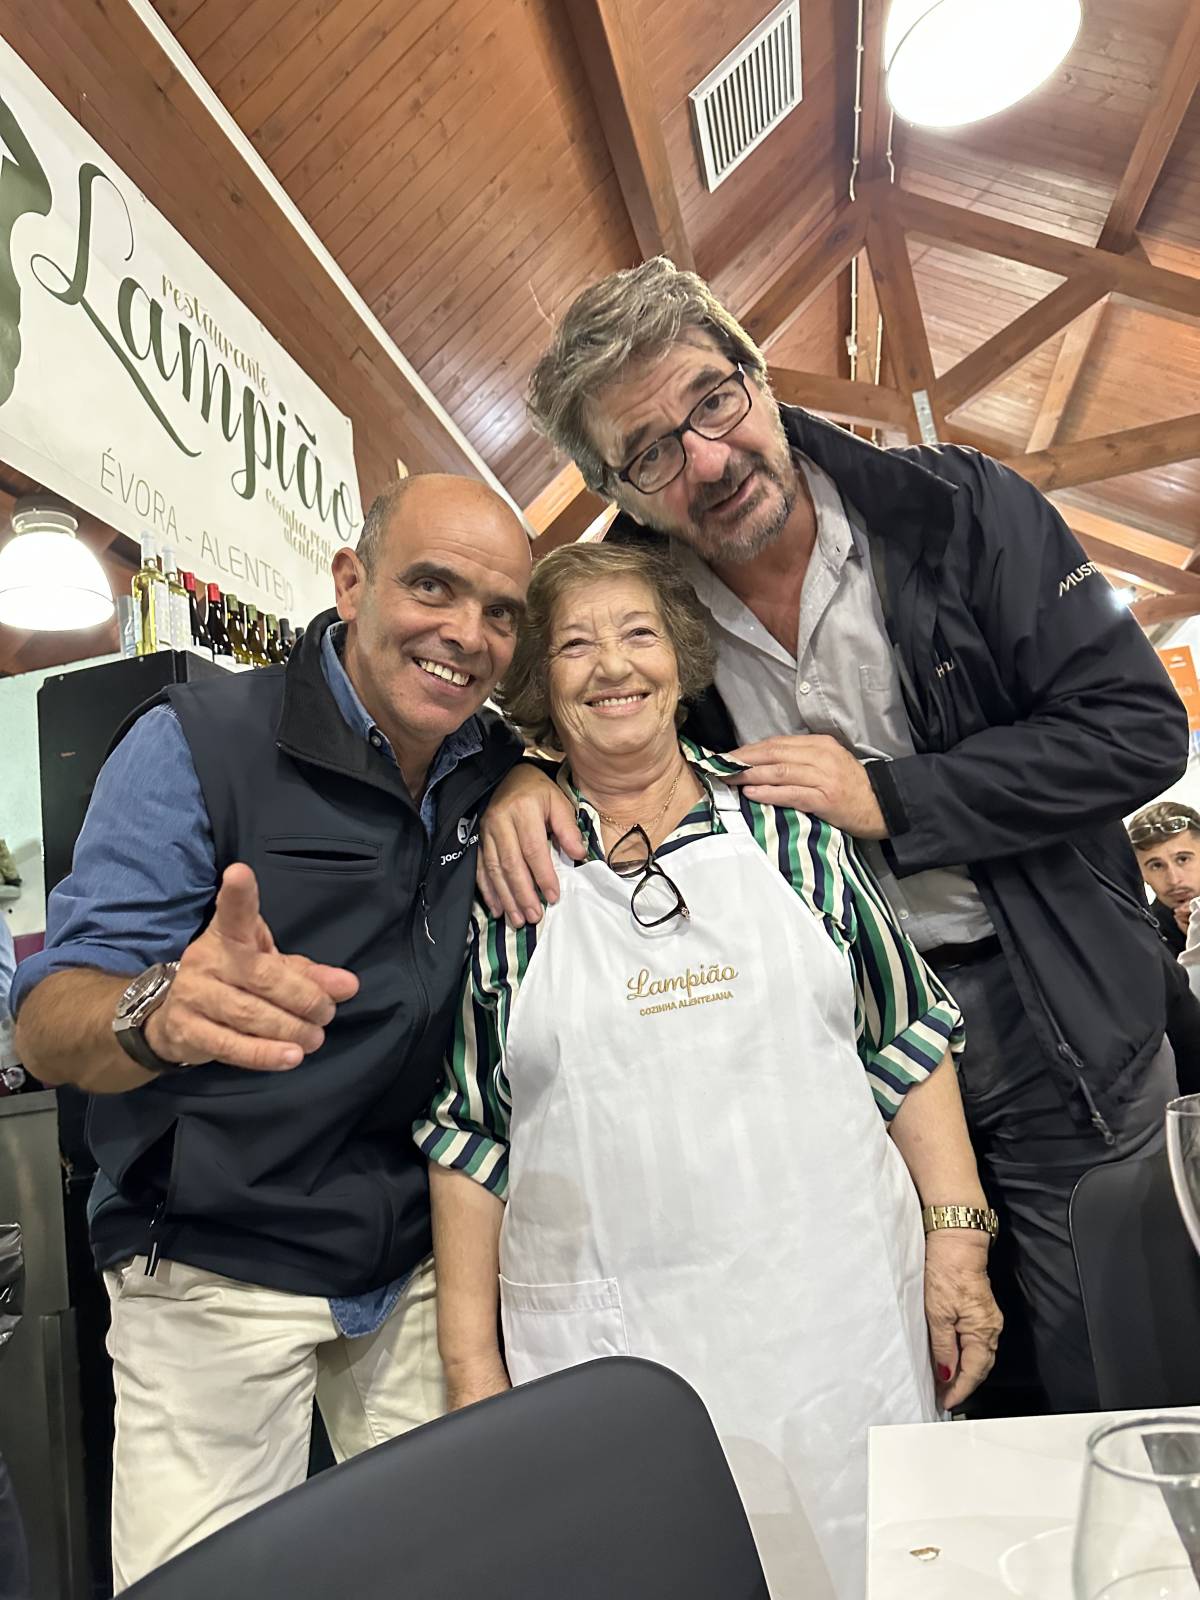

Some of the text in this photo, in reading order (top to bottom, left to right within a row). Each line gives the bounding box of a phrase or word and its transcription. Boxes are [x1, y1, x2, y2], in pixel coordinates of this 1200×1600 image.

[30, 162, 359, 542] Lampião
[162, 273, 271, 397] restaurante
[100, 447, 180, 533] ÉVORA
[626, 963, 740, 1000] Lampião
[640, 990, 734, 1016] COZINHA ALENTEJANA
